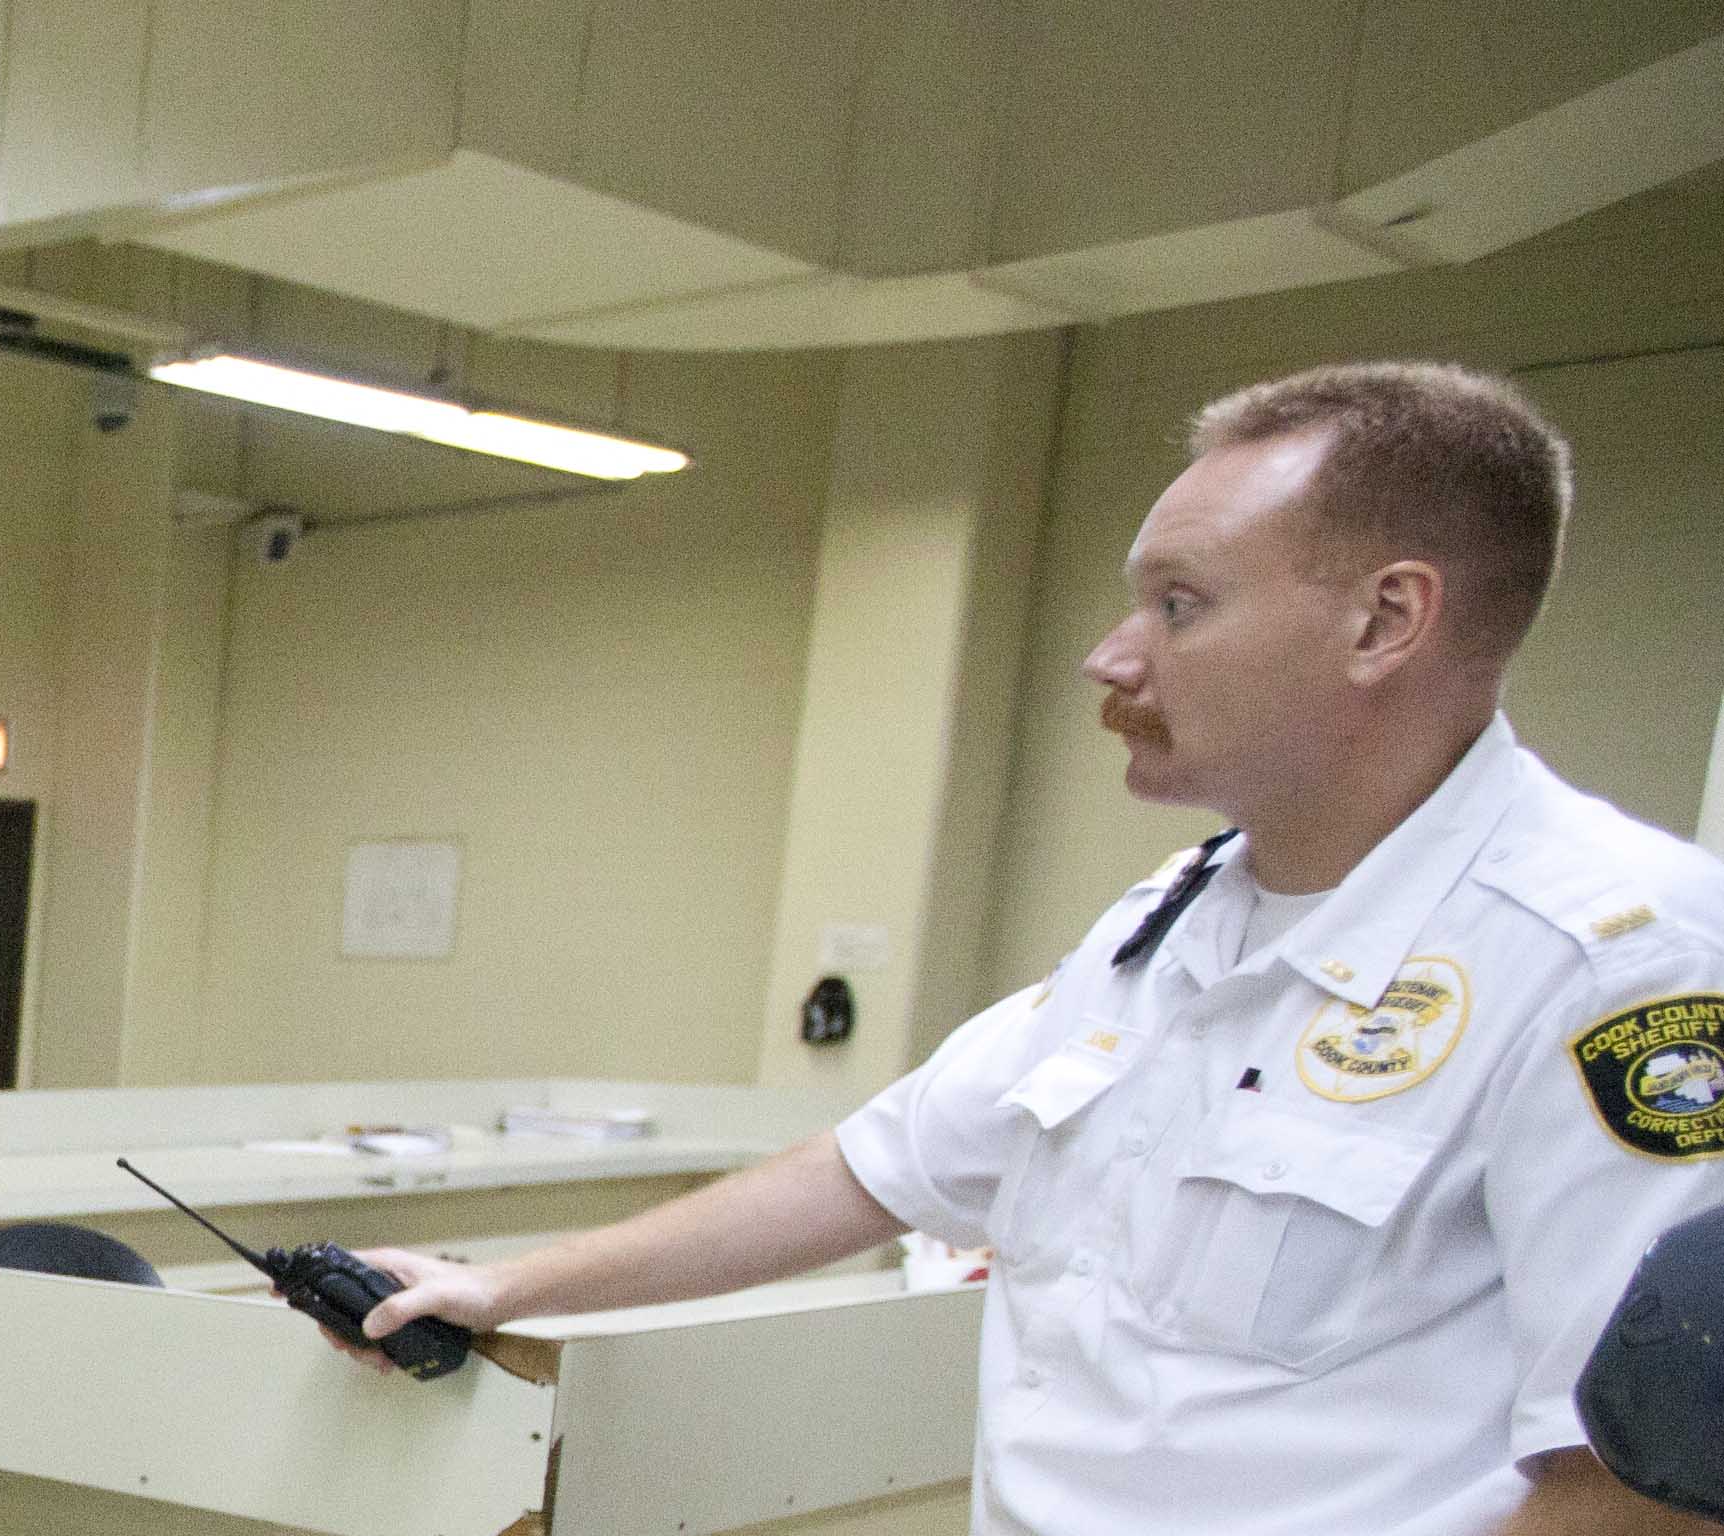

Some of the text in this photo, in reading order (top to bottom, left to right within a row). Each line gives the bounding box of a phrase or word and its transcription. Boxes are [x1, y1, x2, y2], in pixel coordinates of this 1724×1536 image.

[1582, 1017, 1642, 1062] COOK
[1612, 1021, 1720, 1060] SHERIFF
[1348, 1055, 1408, 1075] COUNTY
